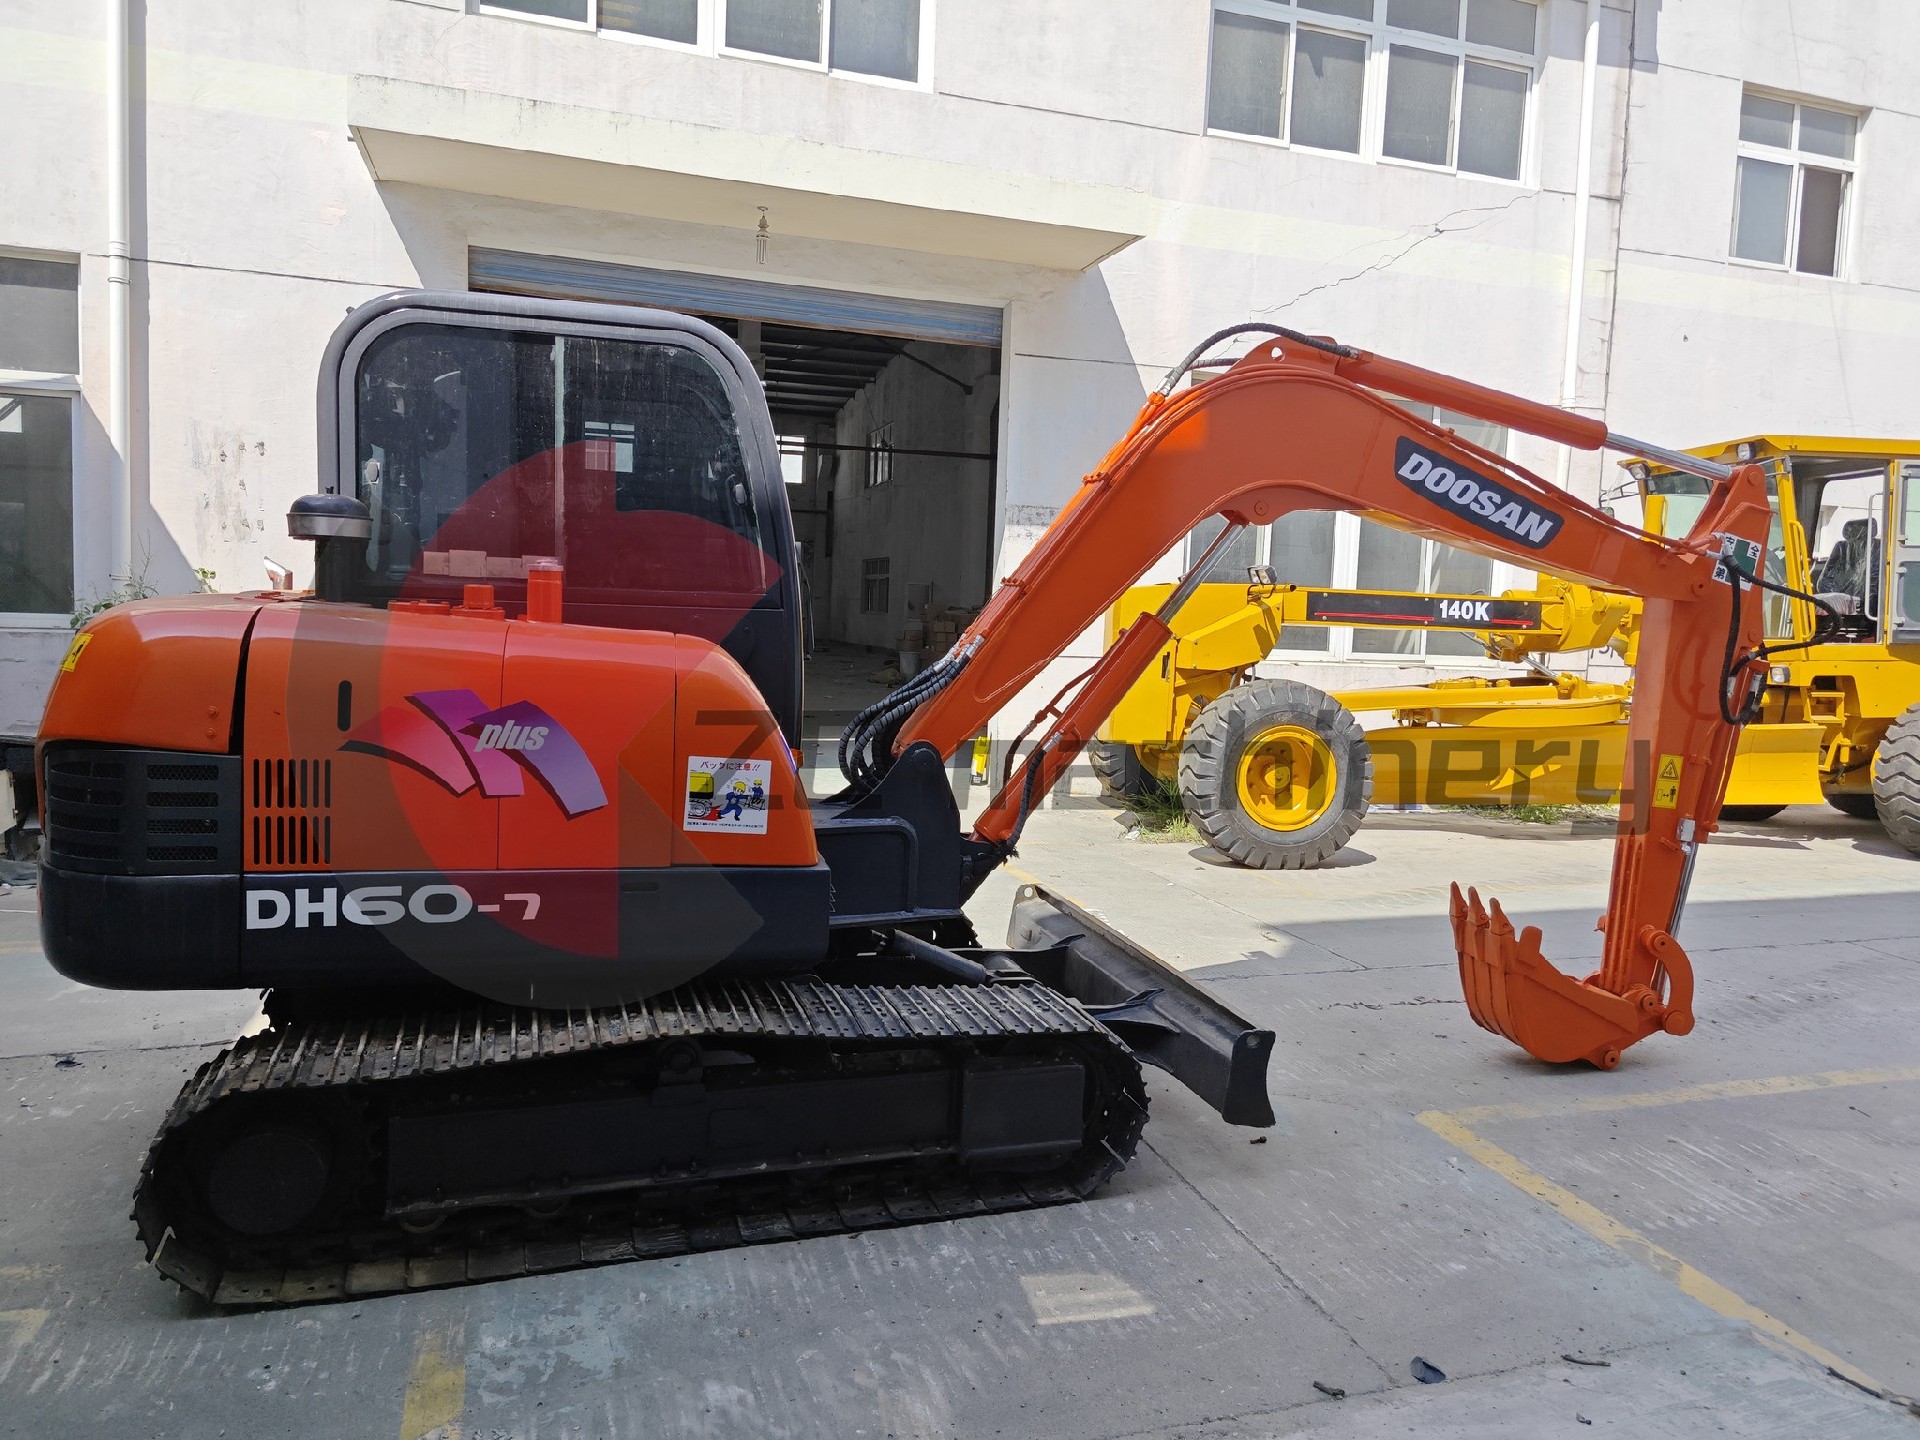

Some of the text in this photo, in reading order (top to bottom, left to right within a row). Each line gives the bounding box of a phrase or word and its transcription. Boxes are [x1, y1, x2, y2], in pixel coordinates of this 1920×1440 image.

[1398, 453, 1553, 543] DOOSAN
[1439, 599, 1491, 621] 140K
[474, 720, 550, 752] plus
[246, 884, 541, 930] DH60-7
